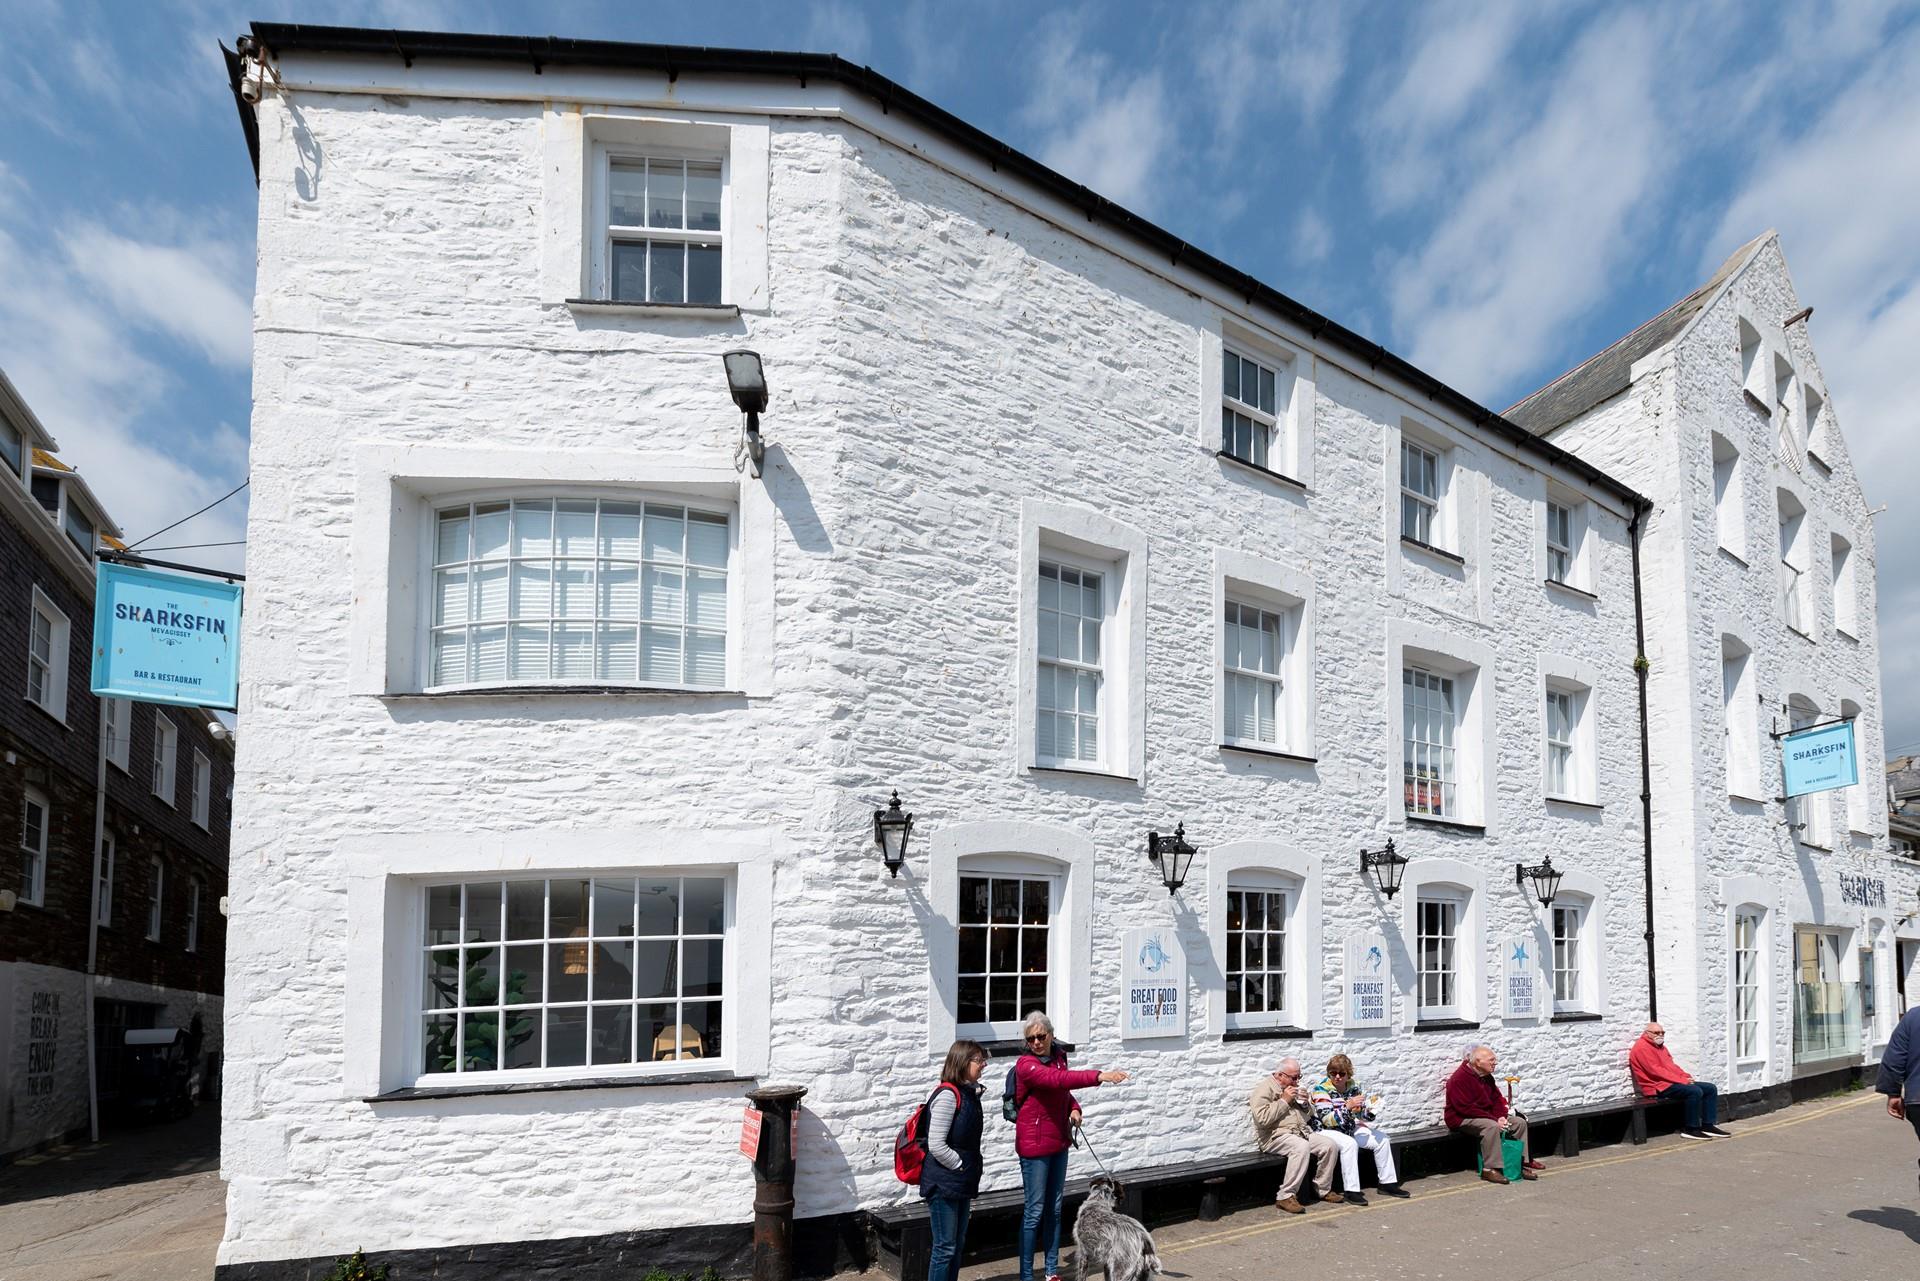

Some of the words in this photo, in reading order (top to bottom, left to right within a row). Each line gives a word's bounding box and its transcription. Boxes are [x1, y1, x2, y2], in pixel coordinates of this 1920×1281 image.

[116, 604, 225, 634] SHARKSFIN
[151, 627, 191, 638] MEVAGISSEY
[134, 670, 148, 679] BAR
[158, 673, 202, 685] RESTAURANT
[1792, 741, 1846, 761] SHARKSFIN
[1353, 982, 1383, 995] BREAKFAST
[1509, 976, 1532, 988] COCKTAILS
[1131, 988, 1156, 1004] GREAT
[1157, 987, 1177, 1003] FOOD
[1517, 987, 1532, 997] GOBLETS
[32, 991, 50, 1014] COME
[1361, 995, 1383, 1007] BURGERS
[1513, 997, 1523, 1006] CRAFT
[1523, 997, 1532, 1006] BEER
[1162, 1003, 1177, 1015] BEER
[1361, 1007, 1383, 1020] SEAFOOD
[1131, 1006, 1140, 1030] &
[30, 1017, 51, 1039] RELAX
[29, 1043, 56, 1073] ENJOY
[27, 1076, 39, 1096] THE
